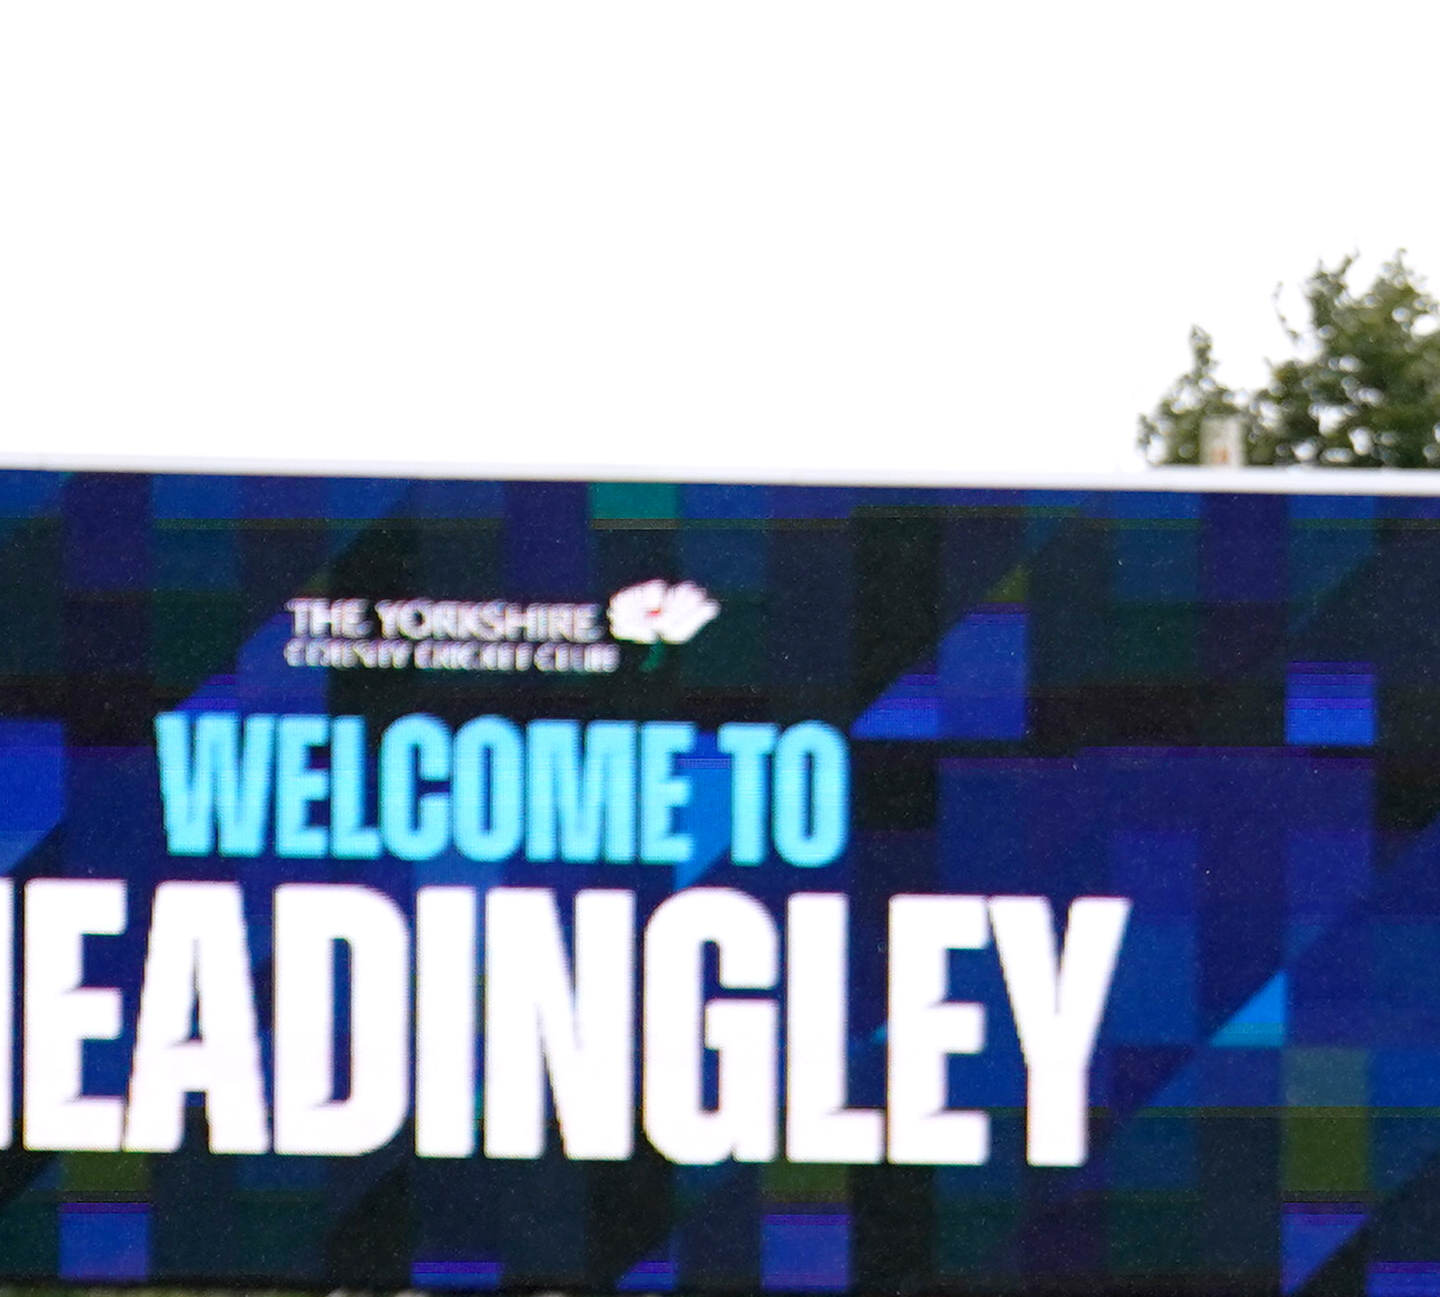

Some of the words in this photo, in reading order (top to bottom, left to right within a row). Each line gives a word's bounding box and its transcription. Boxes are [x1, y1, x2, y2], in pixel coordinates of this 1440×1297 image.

[284, 598, 372, 639] THE
[376, 599, 604, 642] YORKSHIRE
[283, 637, 411, 669] COUNTY
[414, 641, 534, 672] CRICKET
[535, 643, 621, 674] CLUB
[155, 712, 698, 866] WELCOME
[717, 721, 851, 869] TO
